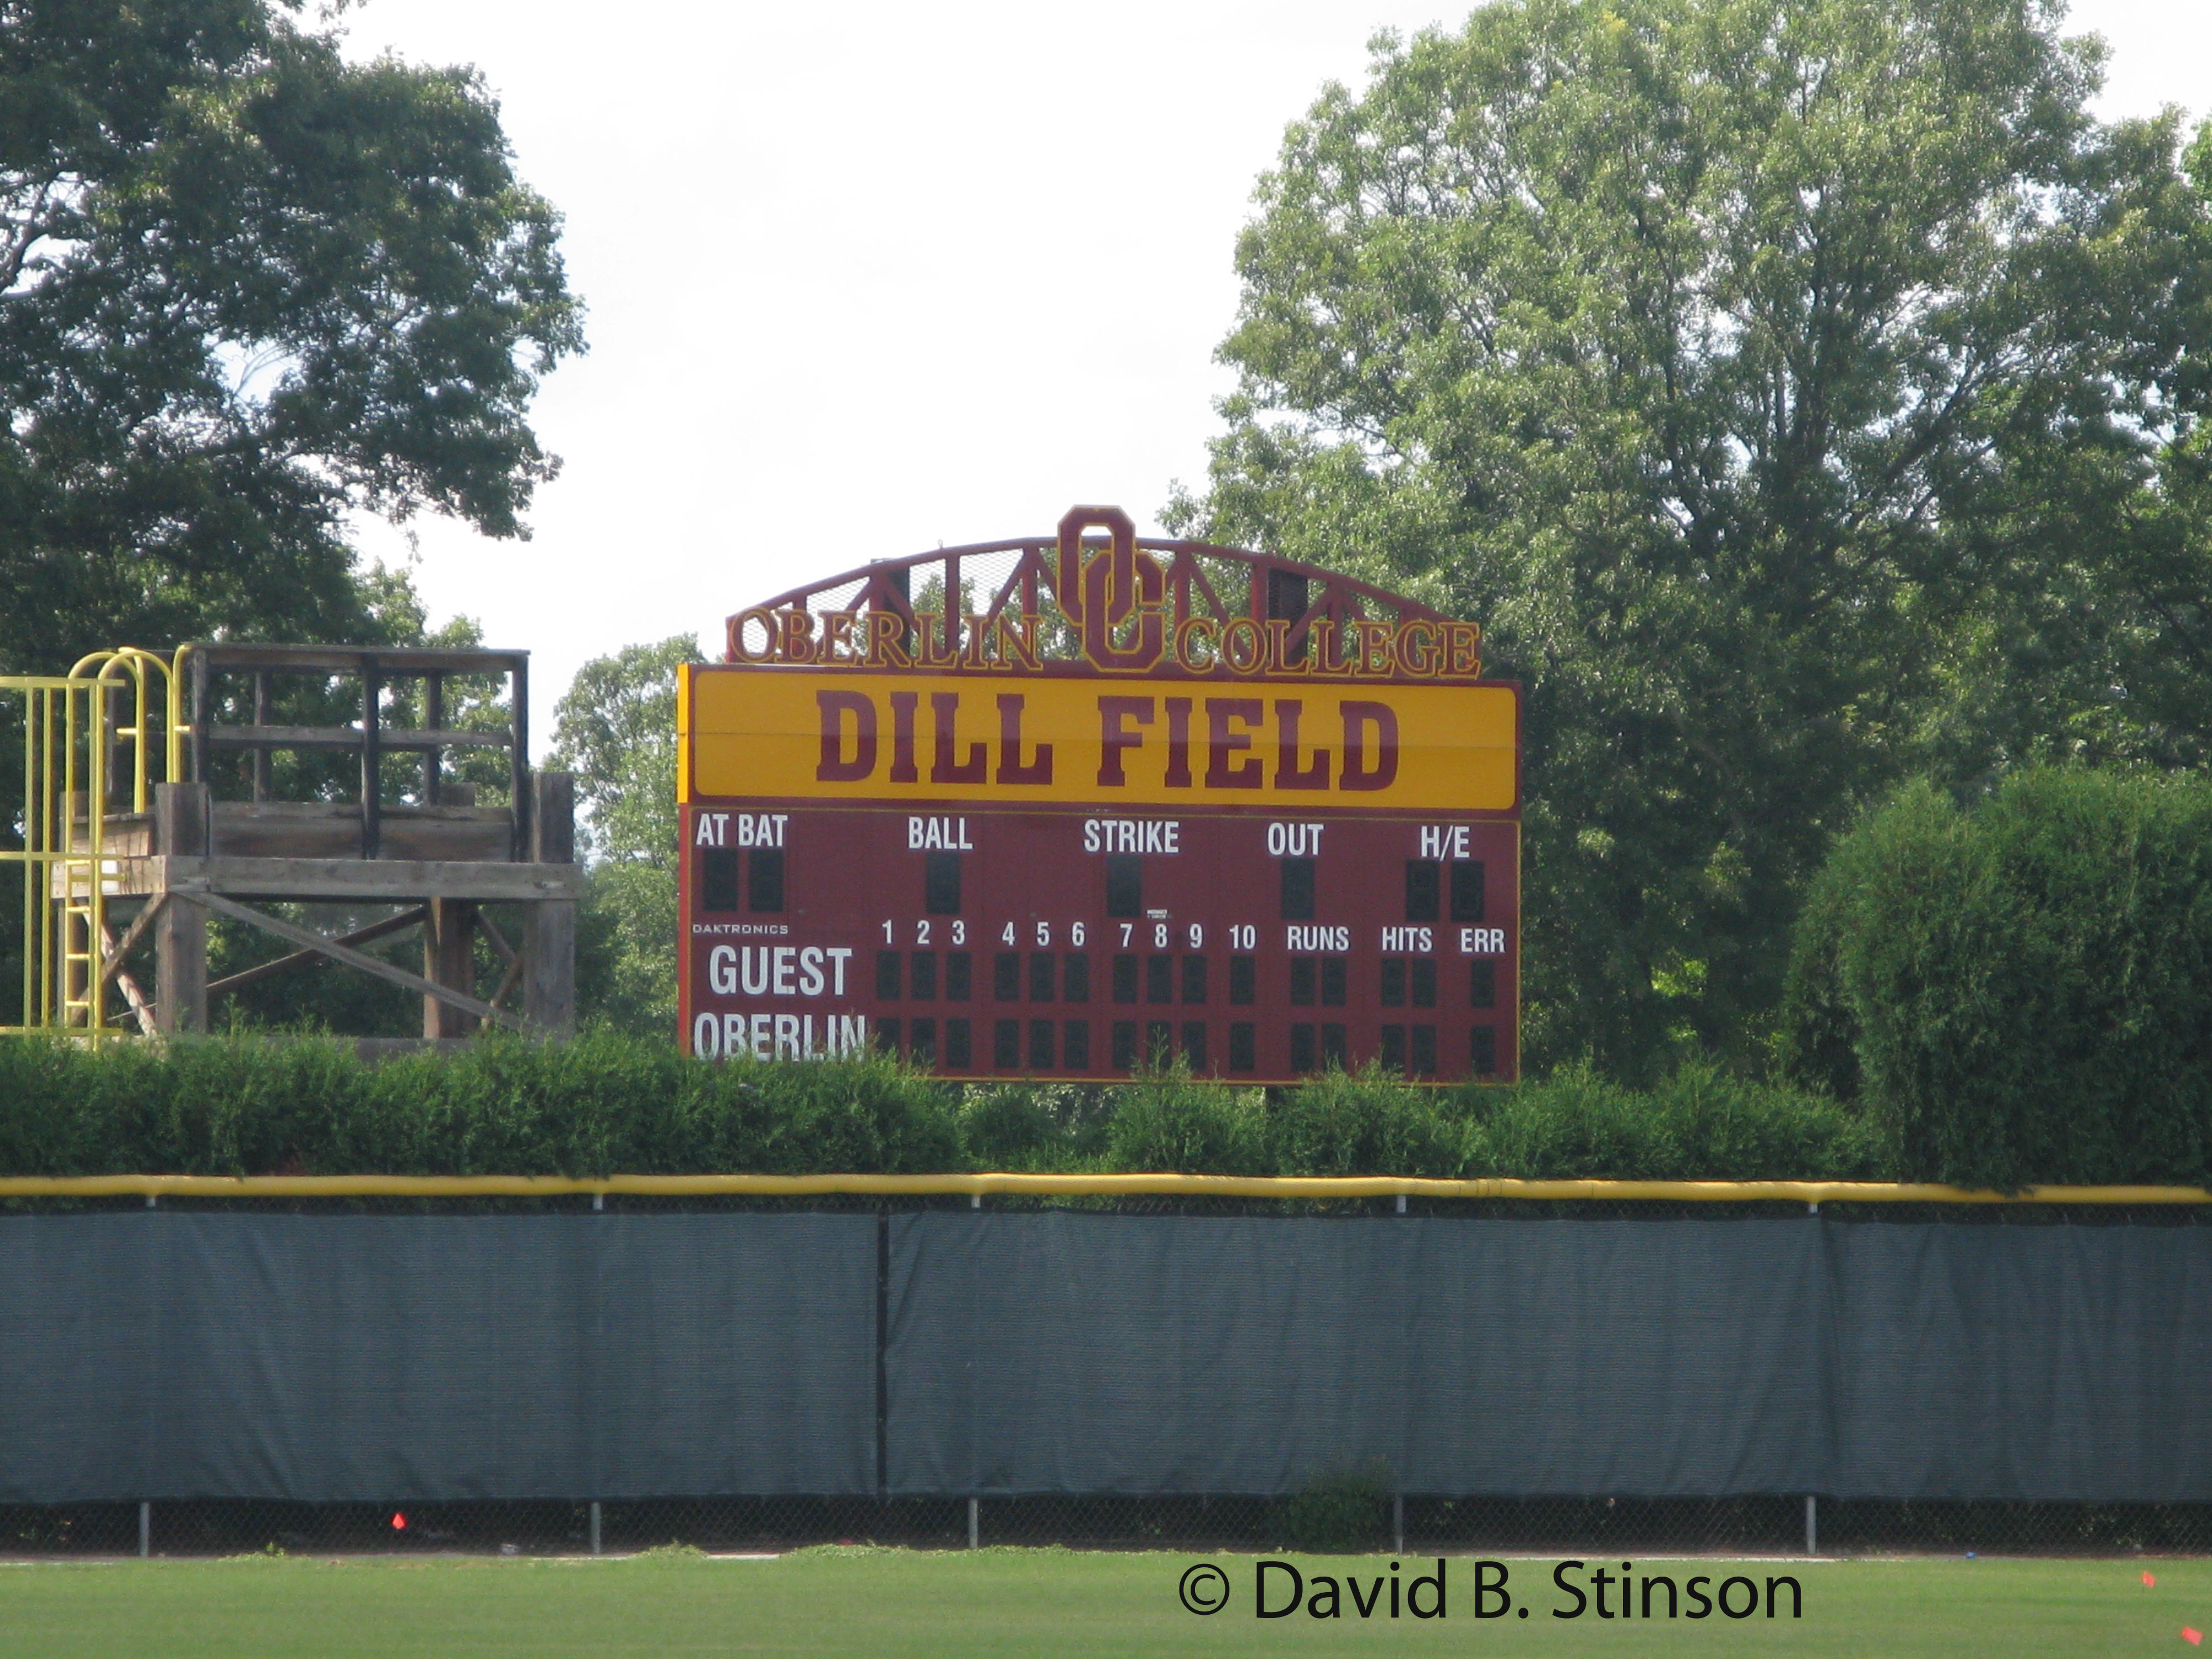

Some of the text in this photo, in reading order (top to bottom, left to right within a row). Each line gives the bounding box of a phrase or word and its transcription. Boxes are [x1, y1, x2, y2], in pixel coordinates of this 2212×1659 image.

[729, 608, 1481, 680] OBERLIN COLLEGE
[816, 690, 1399, 791] DILL FIELD
[696, 813, 787, 847] AT BAT
[908, 817, 972, 849] BALL
[1084, 819, 1179, 853] STRIKE
[1267, 823, 1324, 855] OUT
[1421, 826, 1470, 861] H/E
[692, 924, 789, 935] DAKTRONICS
[883, 920, 1505, 952] 1 2 3 4 5 6 7 8 9 10 RUNS HITS ERR
[709, 945, 852, 995] GUEST
[694, 1013, 865, 1063] OBERLIN
